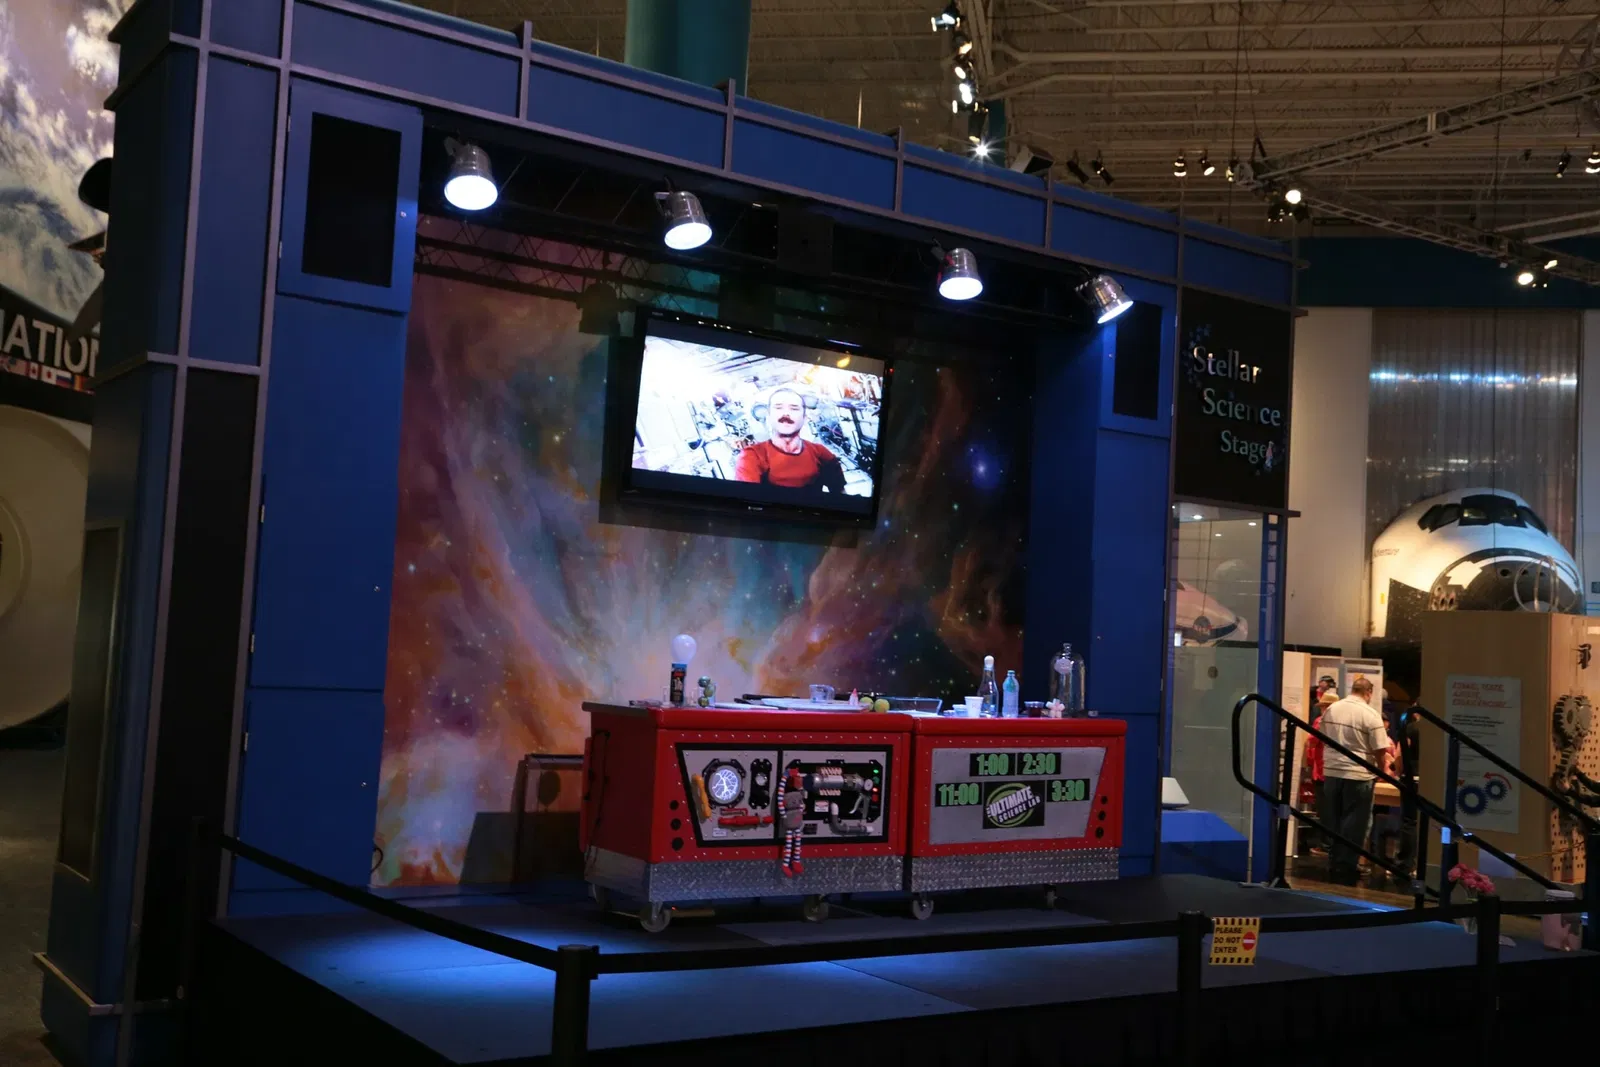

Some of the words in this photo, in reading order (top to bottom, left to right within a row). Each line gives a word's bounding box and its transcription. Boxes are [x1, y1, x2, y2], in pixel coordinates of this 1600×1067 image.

[1192, 345, 1262, 383] Stellar
[1202, 387, 1281, 426] Science
[1220, 429, 1269, 464] Stage
[976, 752, 1009, 775] 1:00
[1022, 752, 1056, 775] 2:30
[938, 782, 980, 806] 11:00
[990, 785, 1034, 817] ULTIMATE
[1051, 780, 1085, 802] 3:30
[998, 803, 1027, 823] SCIENCE
[1028, 795, 1041, 808] LAB
[1214, 936, 1224, 944] DO
[1225, 936, 1241, 944] NOT
[1214, 946, 1238, 954] ENTER
